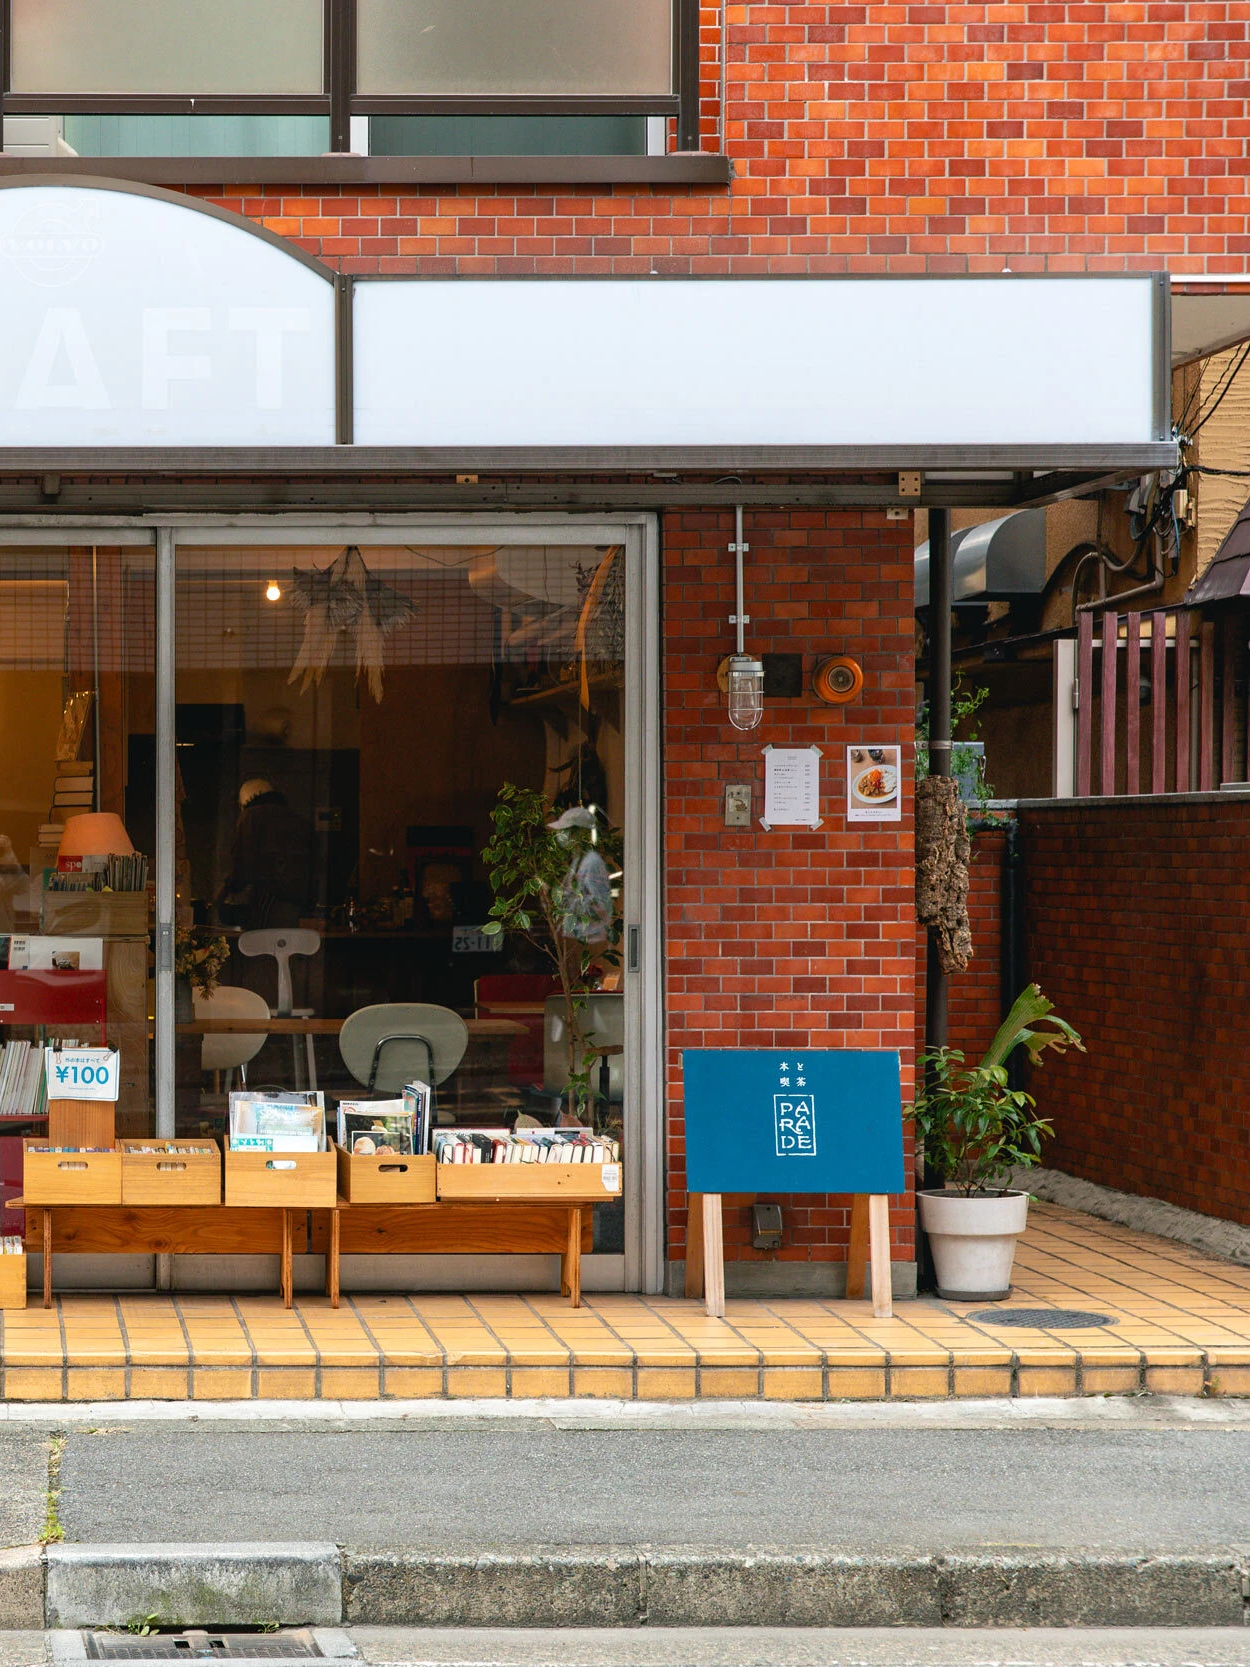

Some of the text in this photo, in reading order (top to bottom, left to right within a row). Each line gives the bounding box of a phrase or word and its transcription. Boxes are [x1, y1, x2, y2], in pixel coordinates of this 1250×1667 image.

[779, 1061, 805, 1072] 本と
[55, 1065, 109, 1085] ¥100
[779, 1076, 807, 1087] 喫茶
